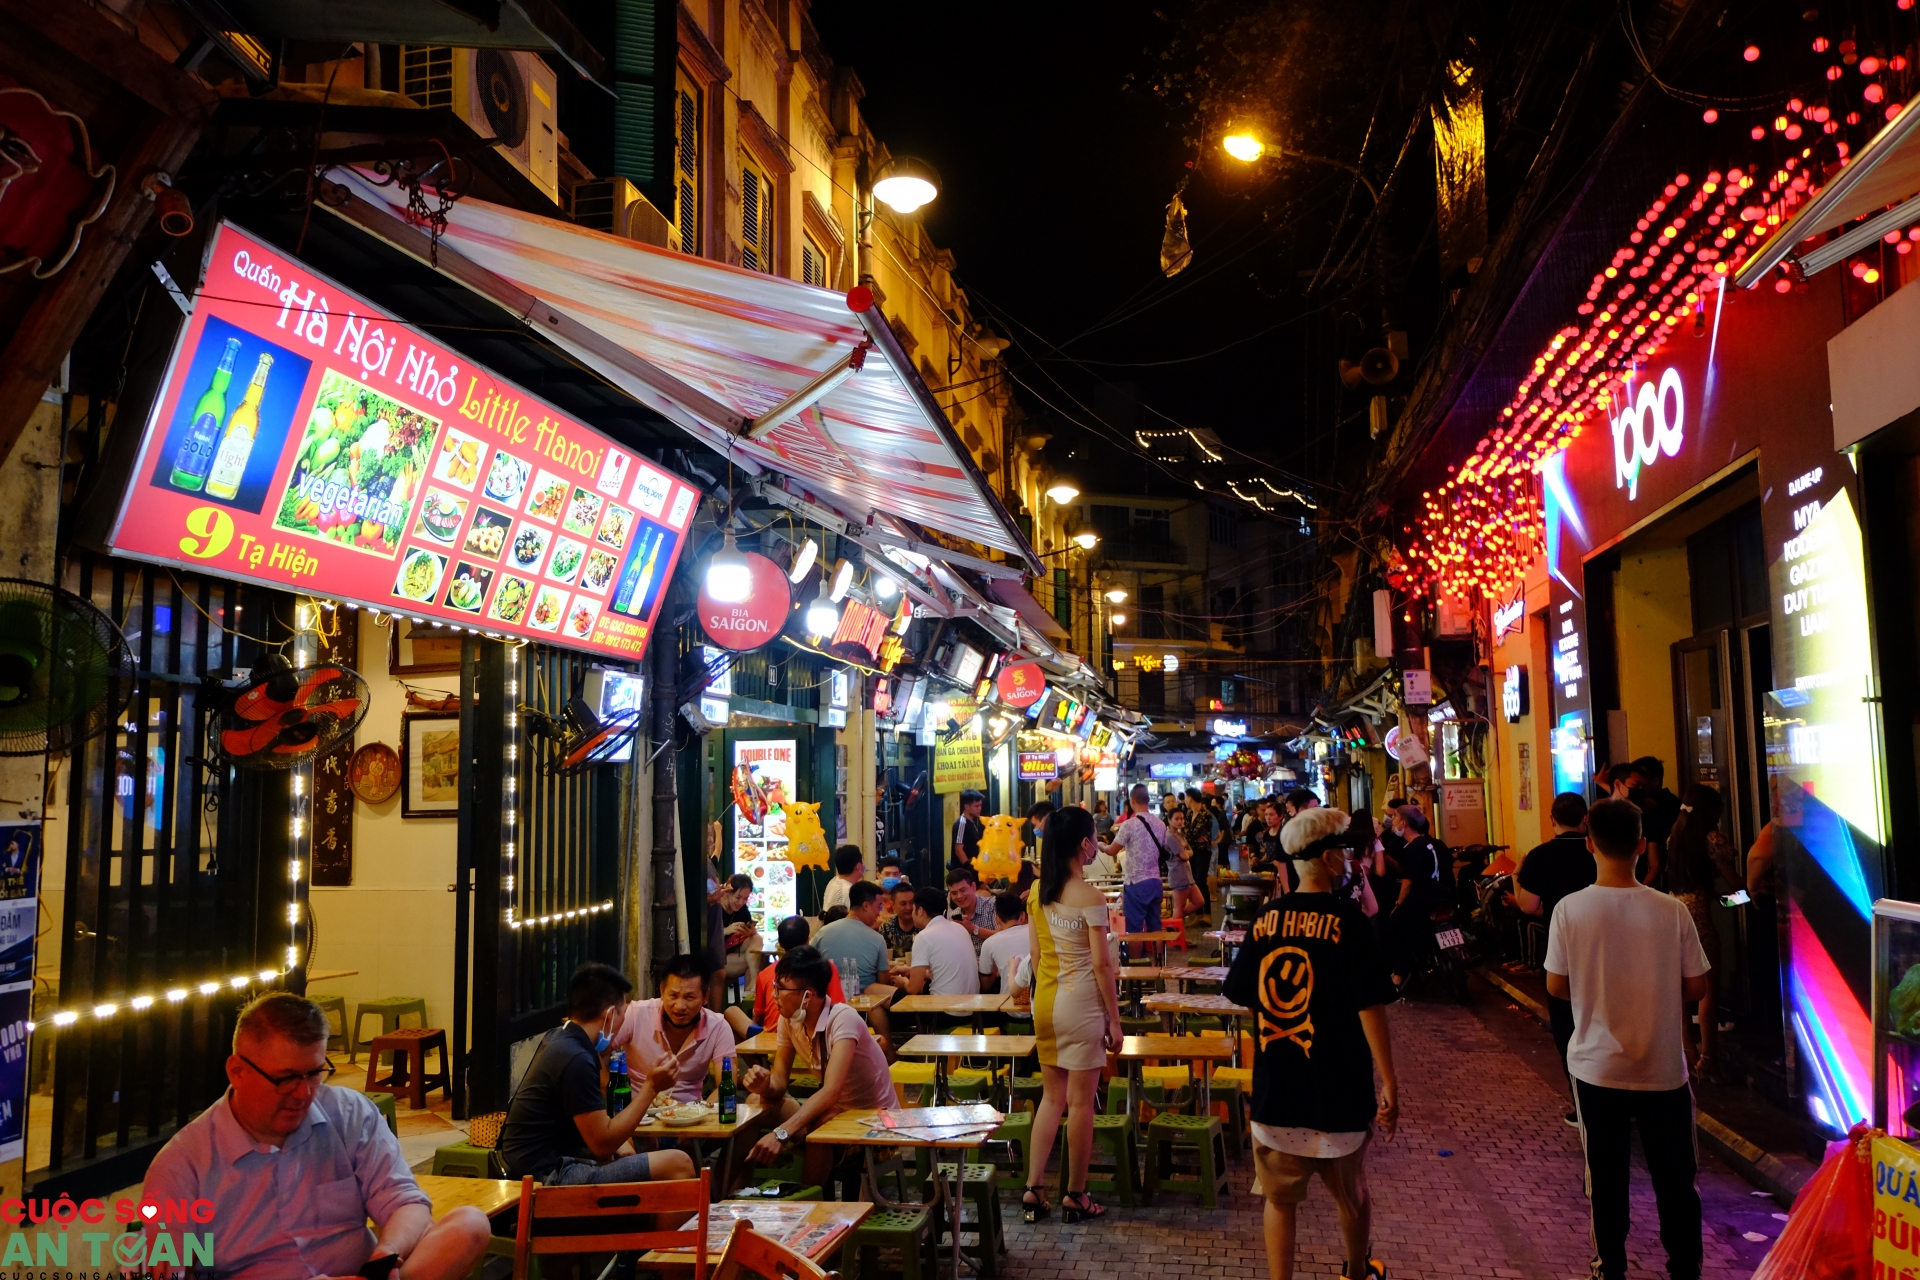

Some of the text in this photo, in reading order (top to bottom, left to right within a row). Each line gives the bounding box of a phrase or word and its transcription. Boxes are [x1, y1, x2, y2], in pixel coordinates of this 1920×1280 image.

[276, 280, 331, 348] Hà
[333, 311, 397, 381] Nội
[395, 344, 459, 407] Nhỏ
[458, 375, 532, 446] Little
[533, 415, 604, 479] Hanoi
[298, 471, 404, 528] vegetarian
[1793, 500, 1821, 531] MYA
[179, 506, 319, 579] 9 Tạ Hiện
[731, 608, 749, 618] BIA
[709, 616, 769, 633] SAIGON
[1133, 654, 1163, 673] Tiger
[1006, 690, 1037, 700] SAIGON
[740, 748, 792, 763] DOUBLE ONE
[936, 760, 957, 771] KHOAI
[1022, 760, 1055, 772] Olive
[1051, 911, 1083, 931] Hanoi
[1281, 910, 1342, 945] HABITS
